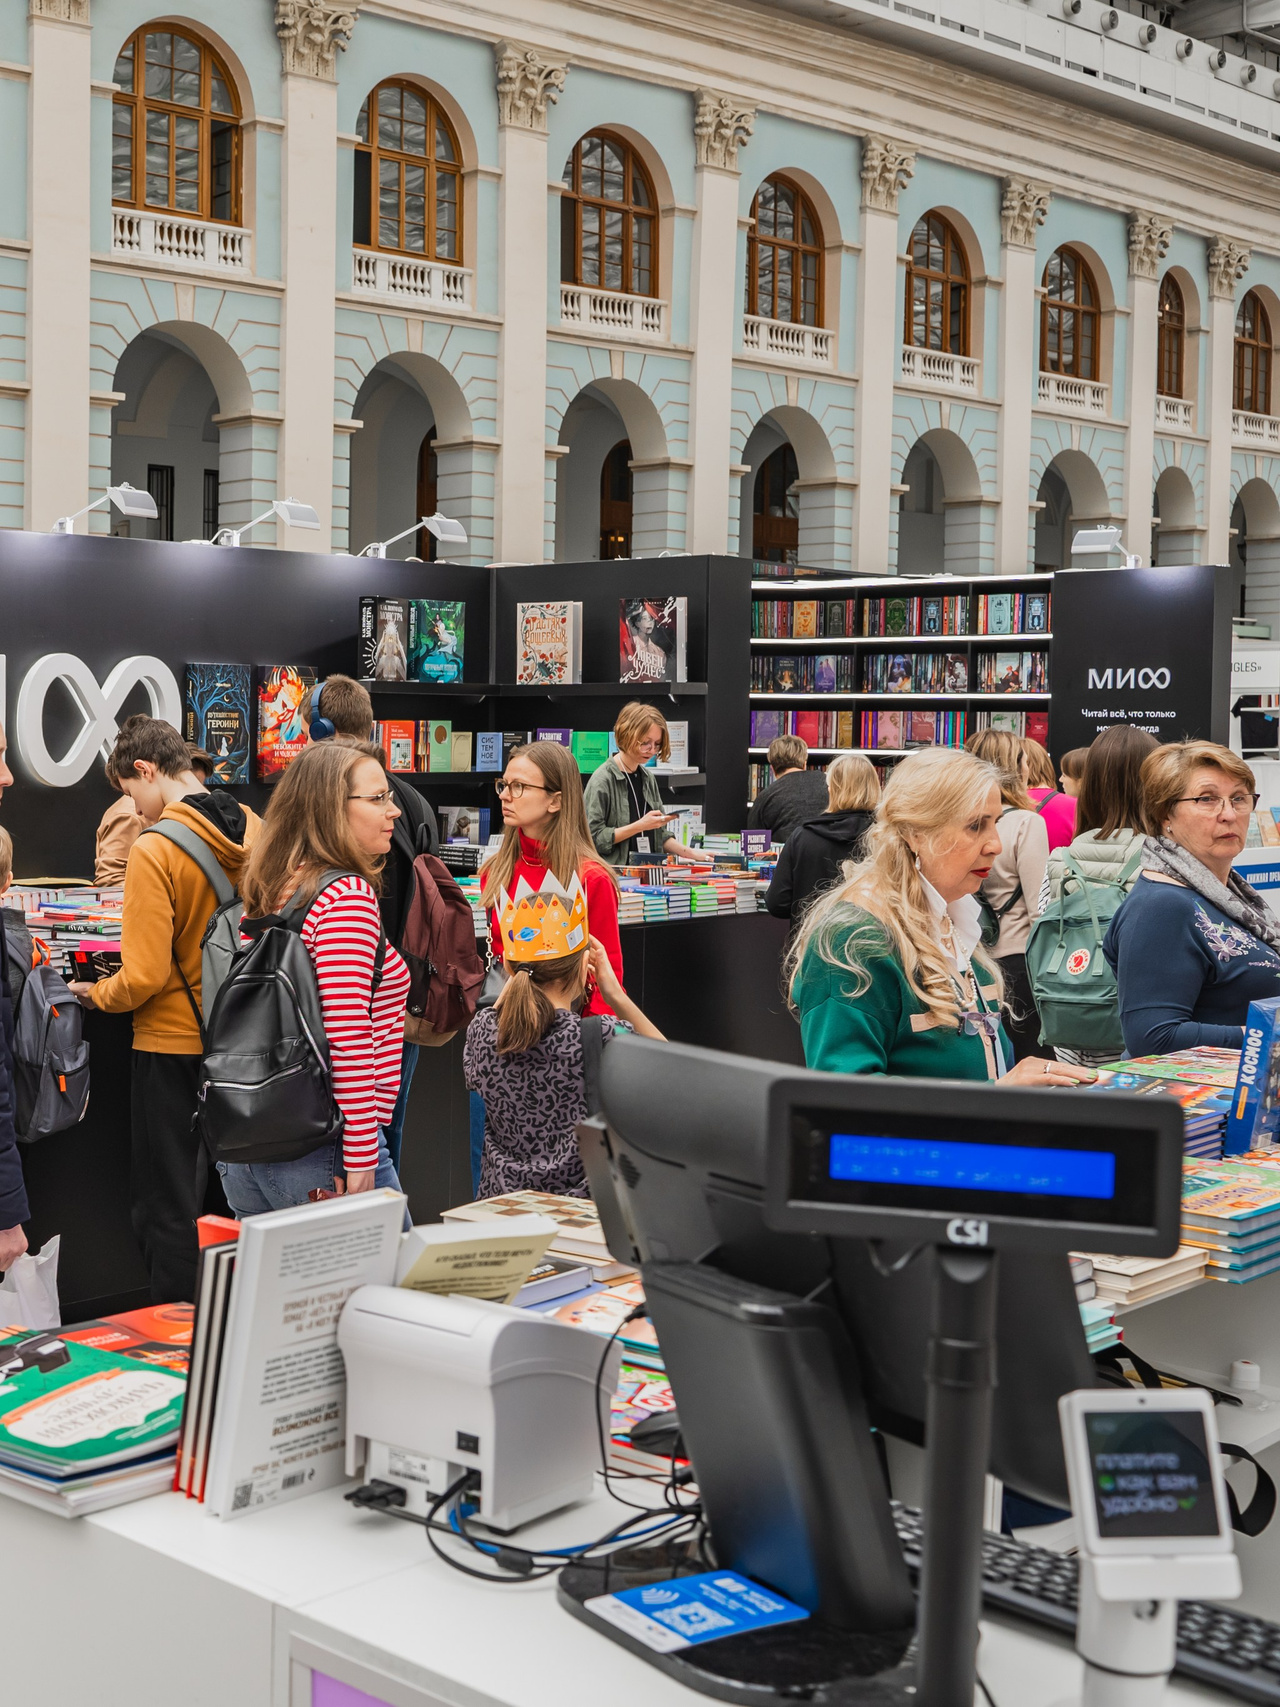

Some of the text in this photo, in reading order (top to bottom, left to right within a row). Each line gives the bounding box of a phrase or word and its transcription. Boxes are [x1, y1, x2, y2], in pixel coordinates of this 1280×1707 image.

[628, 650, 665, 668] ЛОВЕЦ
[629, 659, 665, 680] ЧУДЕС
[1081, 708, 1108, 718] Читай
[1109, 709, 1128, 719] всё,
[207, 720, 239, 729] ГЕРОИНИ
[481, 744, 494, 752] ТЕМ
[1240, 1028, 1264, 1085] КОСМОС
[946, 1218, 989, 1246] CSI
